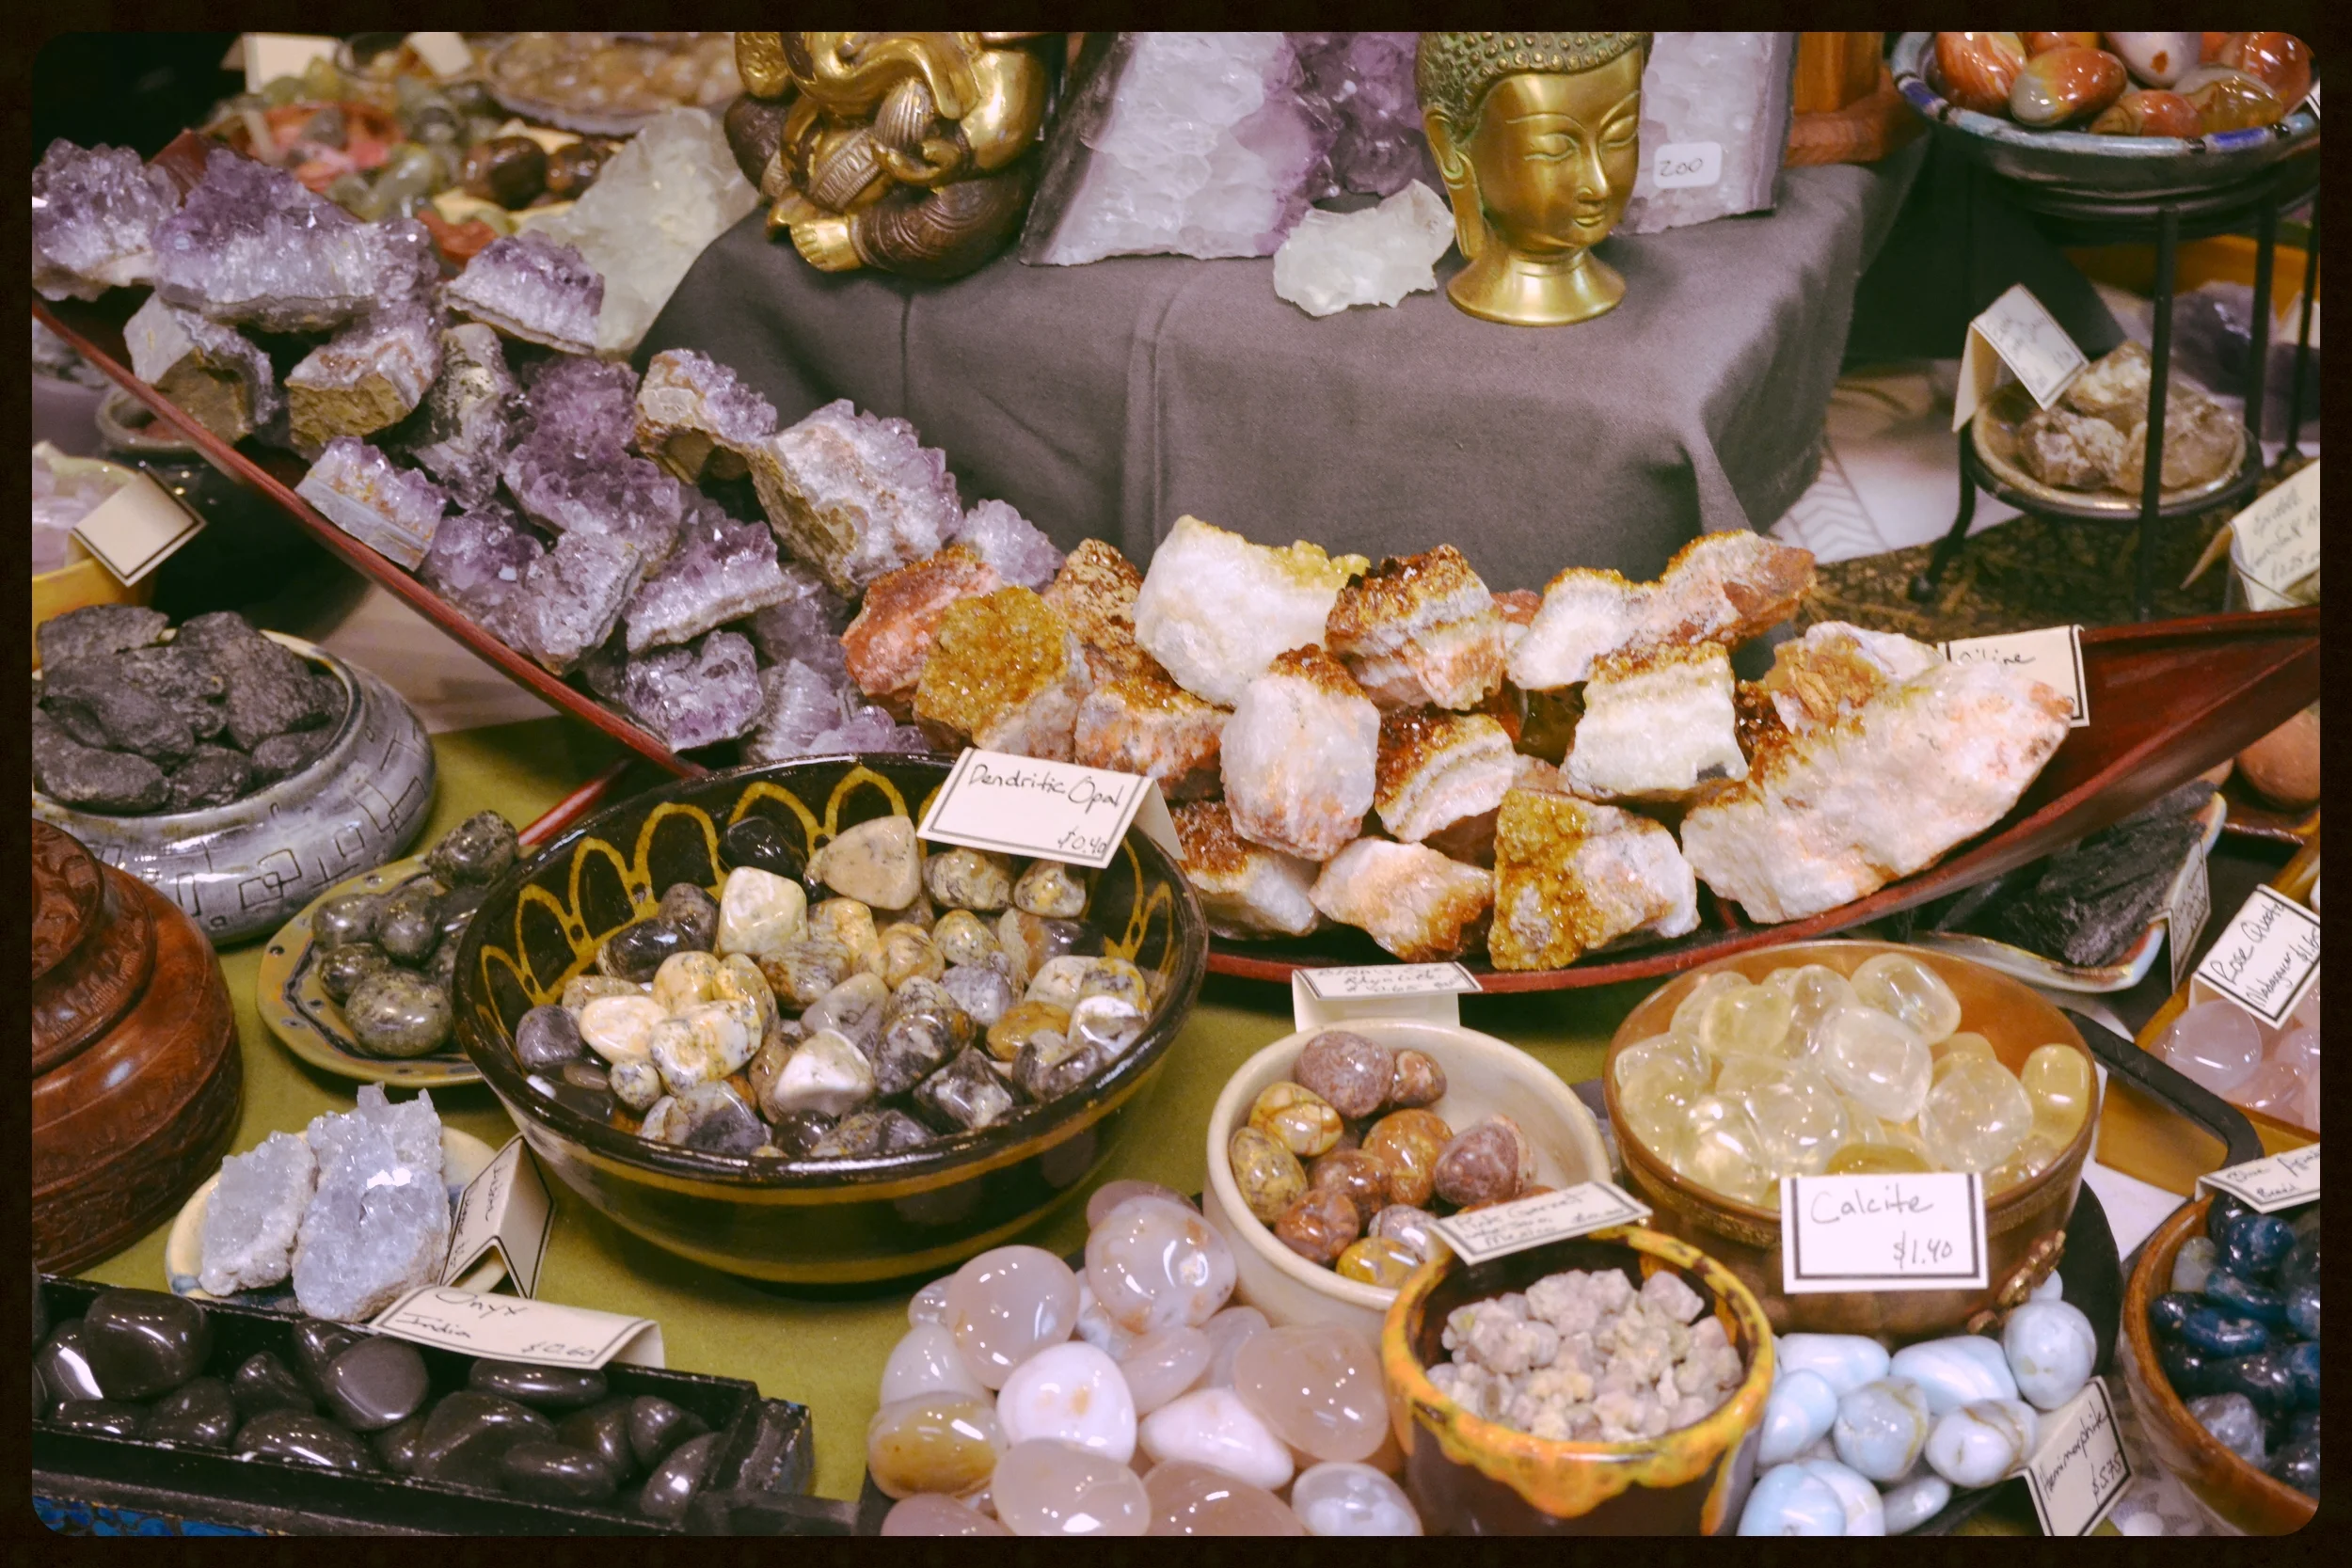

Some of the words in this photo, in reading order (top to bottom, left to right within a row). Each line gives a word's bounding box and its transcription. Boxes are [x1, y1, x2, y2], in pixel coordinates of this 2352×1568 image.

[1660, 157, 1704, 177] 200
[968, 764, 1065, 794] Dendritic
[1068, 774, 1124, 815] Opal
[2210, 945, 2255, 987] Rose
[1810, 1182, 1934, 1225] Calcite
[1893, 1230, 1953, 1271] $1.40
[396, 1311, 471, 1339] India
[436, 1290, 530, 1319] Onyx
